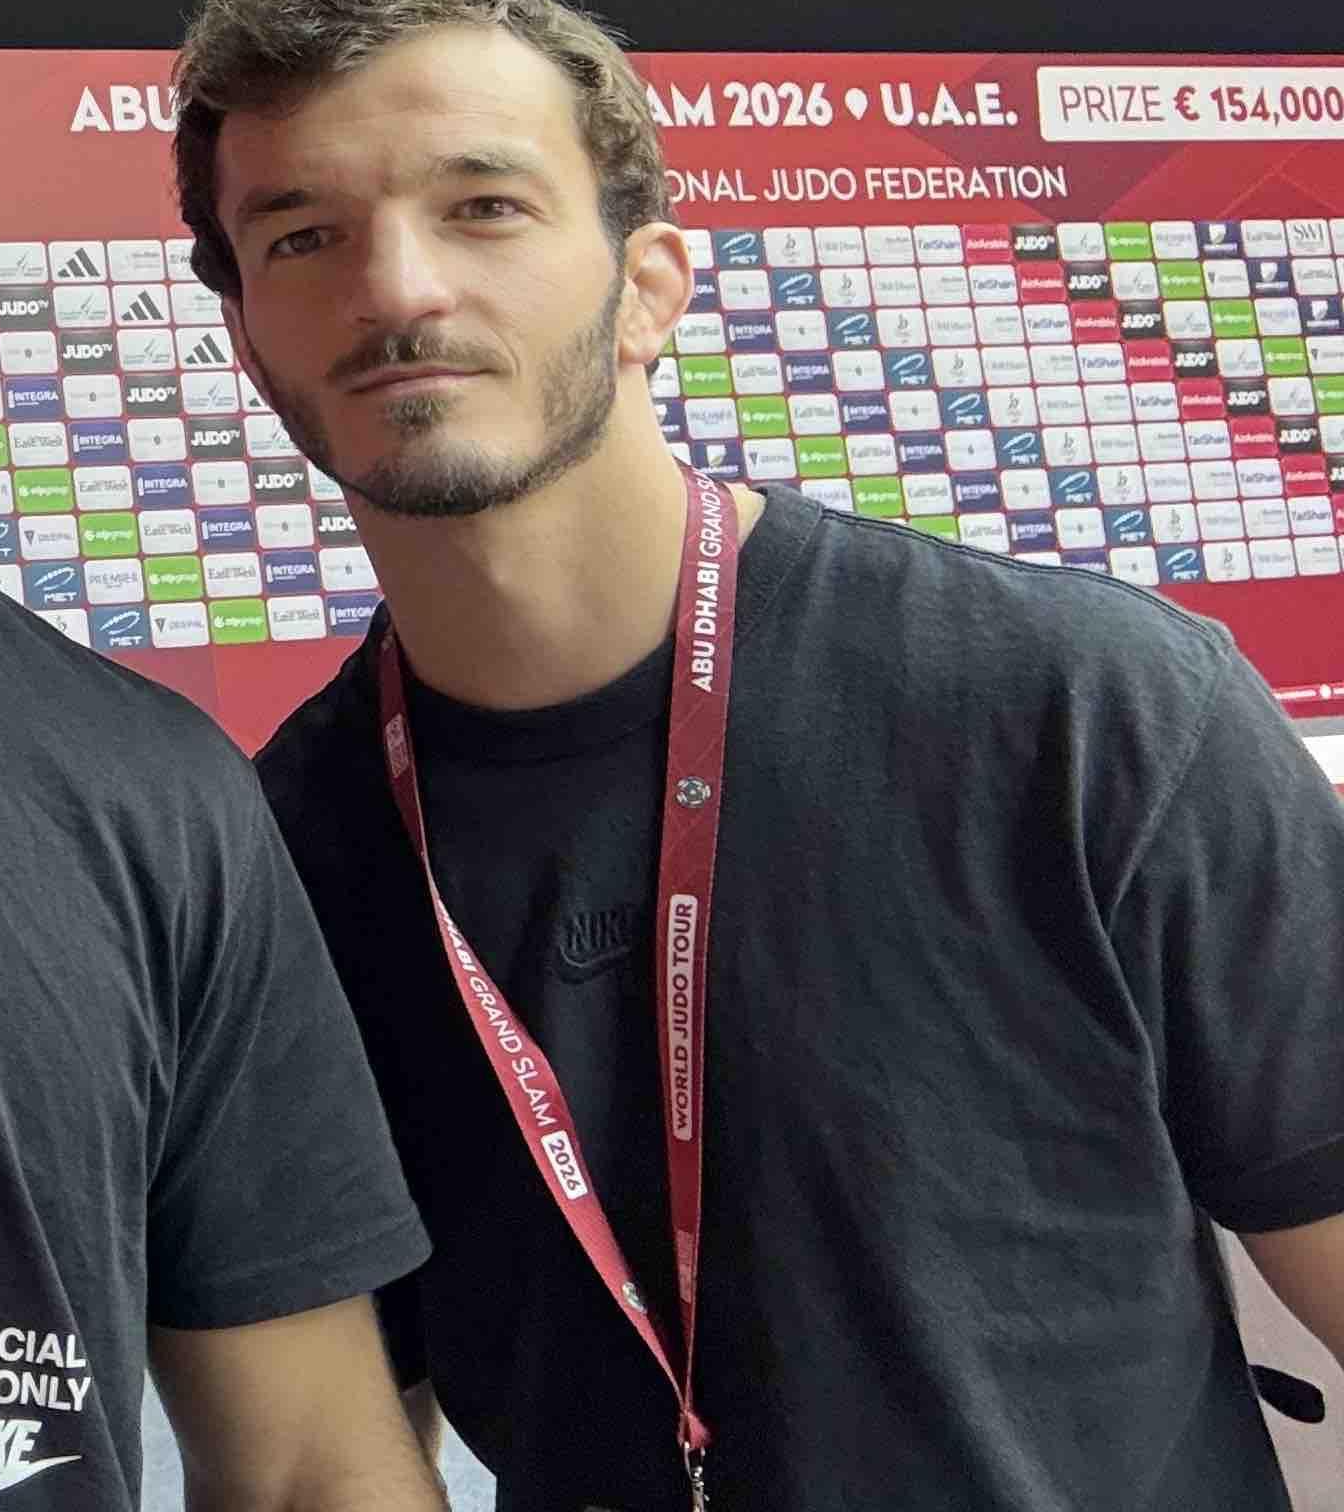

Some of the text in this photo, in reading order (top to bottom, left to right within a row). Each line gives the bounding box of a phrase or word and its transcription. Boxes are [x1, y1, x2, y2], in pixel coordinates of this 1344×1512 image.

[70, 85, 178, 132] ABU
[723, 81, 833, 127] 2026
[880, 82, 1019, 127] U.A.E.
[1060, 85, 1344, 126] PRIZE € 154,000
[764, 167, 857, 202] JUDO
[864, 165, 1069, 200] FEDERATION
[699, 489, 723, 558] GRAND
[694, 560, 721, 636] DHABI
[691, 639, 716, 693] ABU
[673, 902, 694, 1129] WORLD JUDO TOUR
[470, 976, 522, 1053] GRAND
[512, 1055, 558, 1128] SLAM
[549, 1138, 580, 1192] 2026
